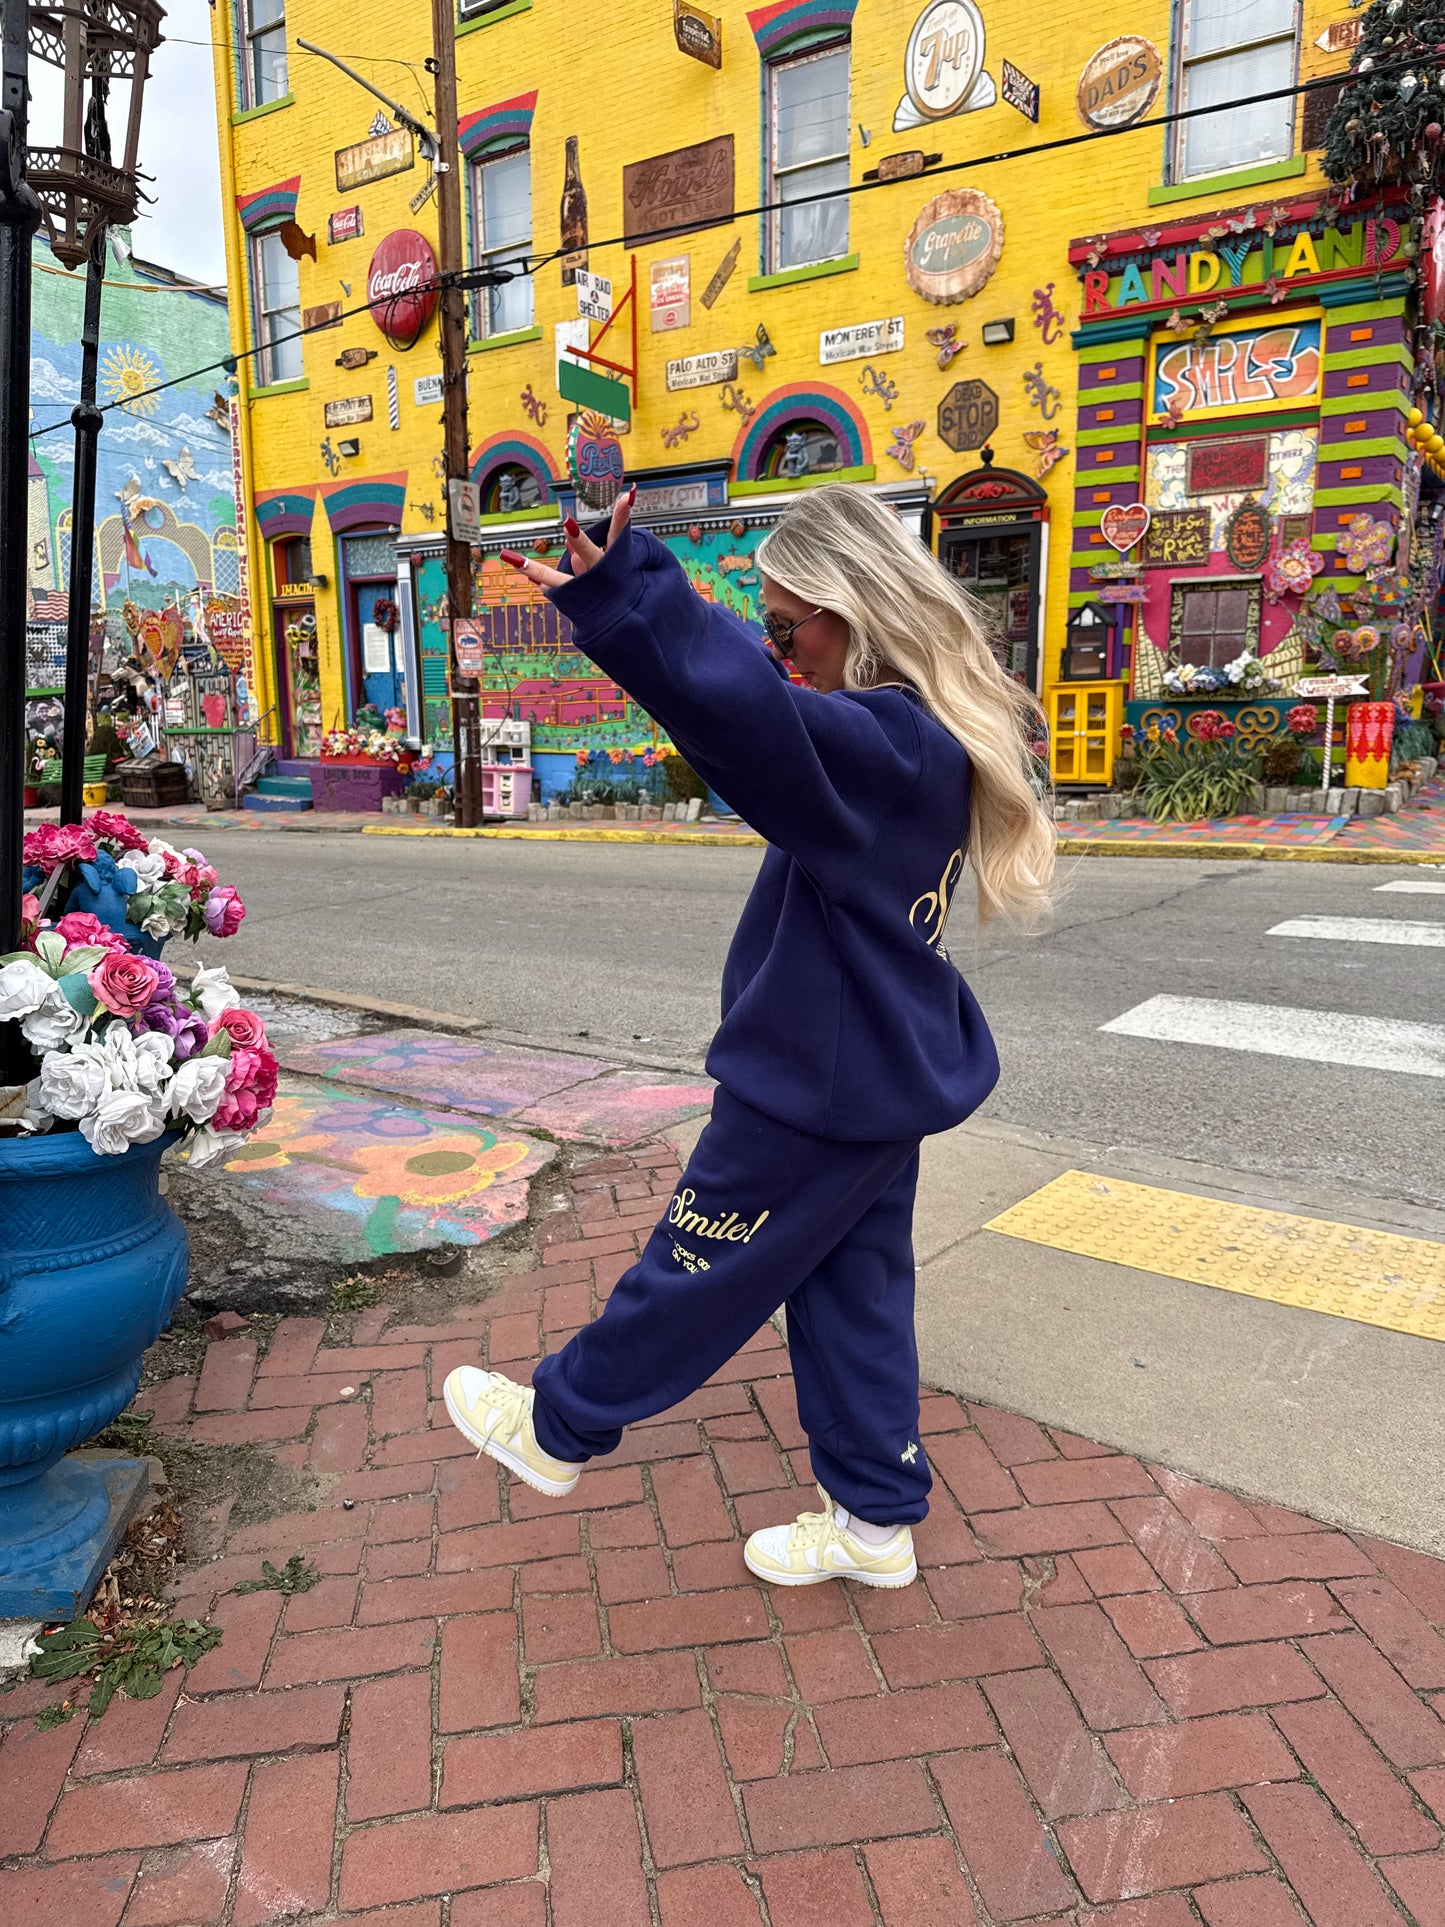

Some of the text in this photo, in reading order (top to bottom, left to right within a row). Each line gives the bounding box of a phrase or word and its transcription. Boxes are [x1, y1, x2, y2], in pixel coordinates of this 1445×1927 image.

[1328, 20, 1360, 46] WEST
[1088, 53, 1147, 110] DAD'S
[920, 221, 983, 265] Grapette
[1083, 218, 1400, 312] RANDYLAND
[370, 261, 422, 299] Coca-Cola
[576, 271, 611, 295] AIR RAID
[580, 300, 610, 323] SHELTER
[825, 324, 883, 347] MONTEREY
[669, 358, 693, 375] PALO
[696, 355, 718, 370] ALTO
[954, 385, 982, 403] DEAD
[941, 400, 994, 433] STOP
[957, 430, 979, 447] END
[677, 486, 706, 502] CITY
[963, 513, 1017, 526] INFORMATION
[239, 554, 251, 629] WELCOME
[669, 1188, 770, 1243] Smile!
